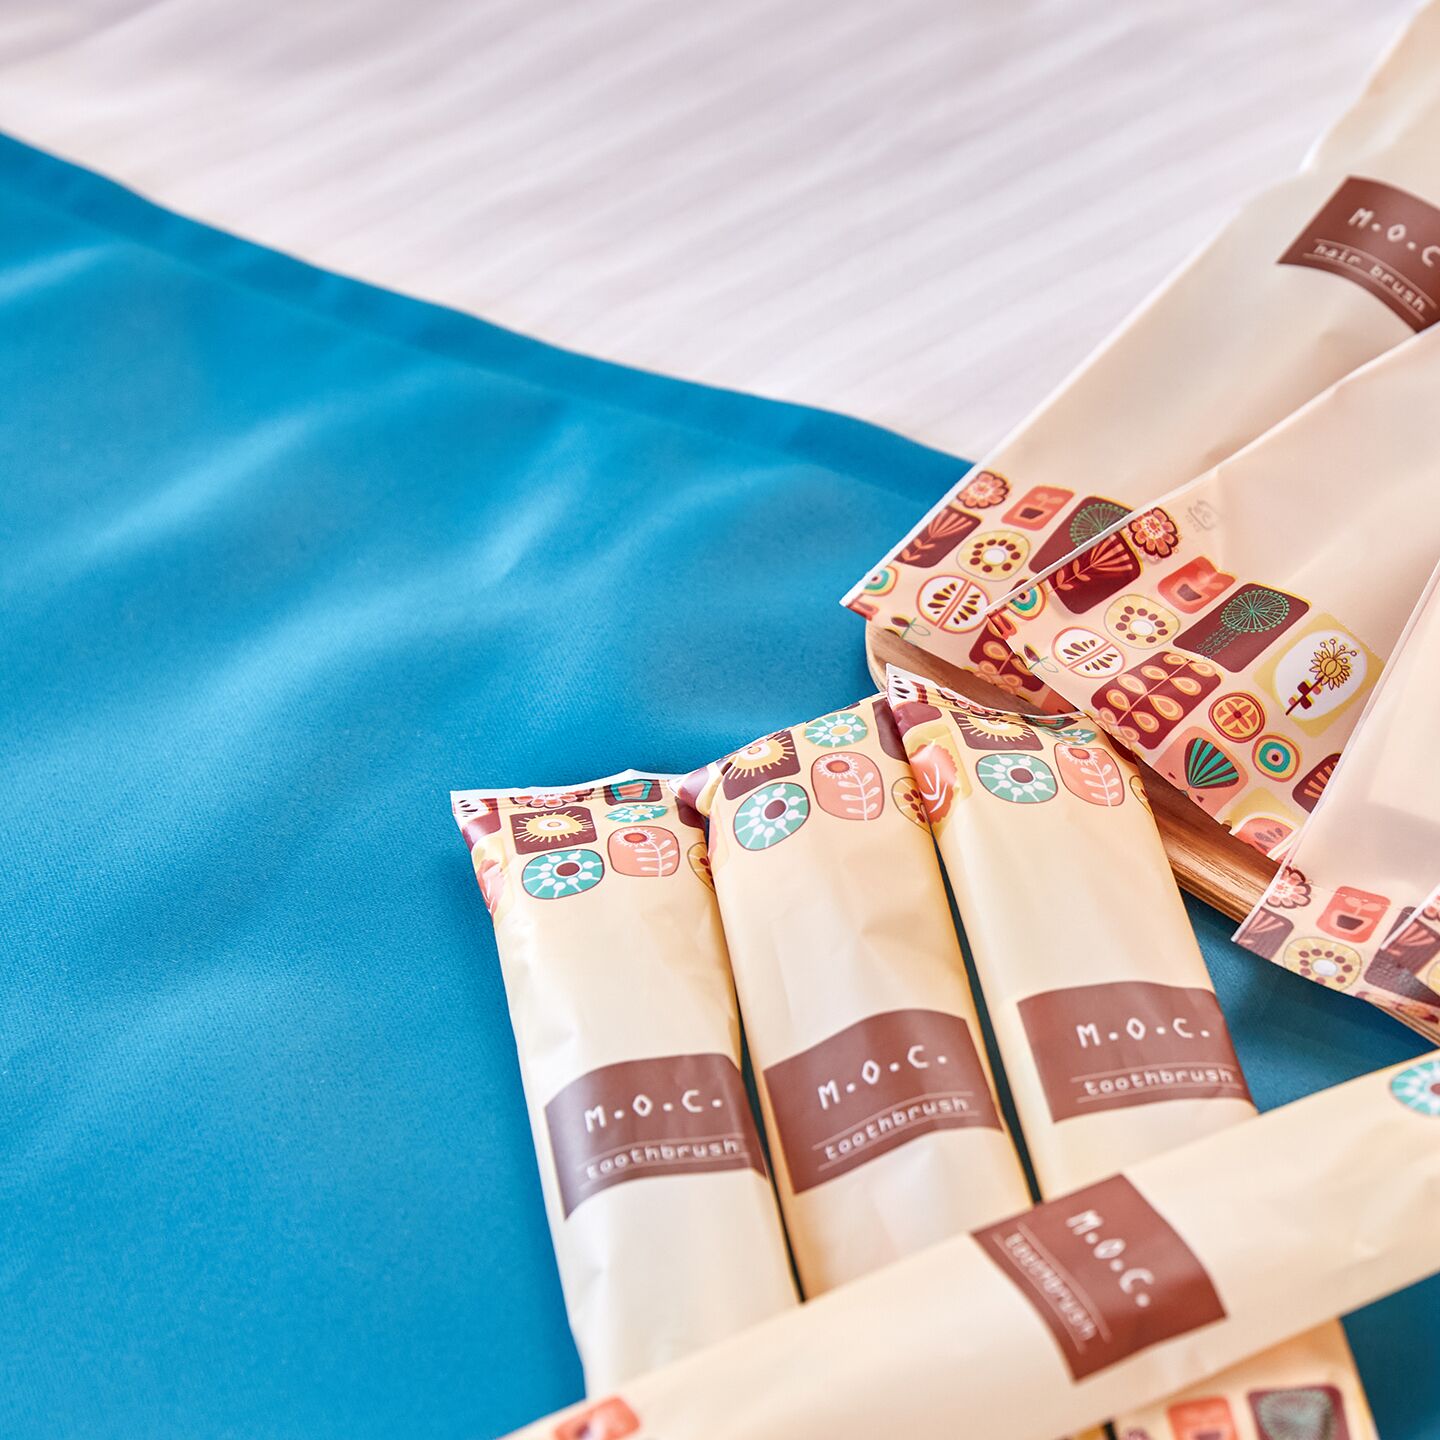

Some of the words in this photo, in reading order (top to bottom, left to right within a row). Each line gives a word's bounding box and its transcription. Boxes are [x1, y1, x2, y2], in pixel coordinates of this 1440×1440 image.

[1313, 242, 1362, 266] hair
[1369, 265, 1428, 313] brush
[1077, 1017, 1211, 1049] M.O.C.
[818, 1043, 948, 1110] M.O.C.
[1084, 1065, 1235, 1096] toothbrush
[584, 1089, 724, 1133] M.O.C.
[825, 1097, 969, 1161] toothbrush
[585, 1138, 740, 1180] toothbrush
[1065, 1208, 1153, 1309] M.O.C.
